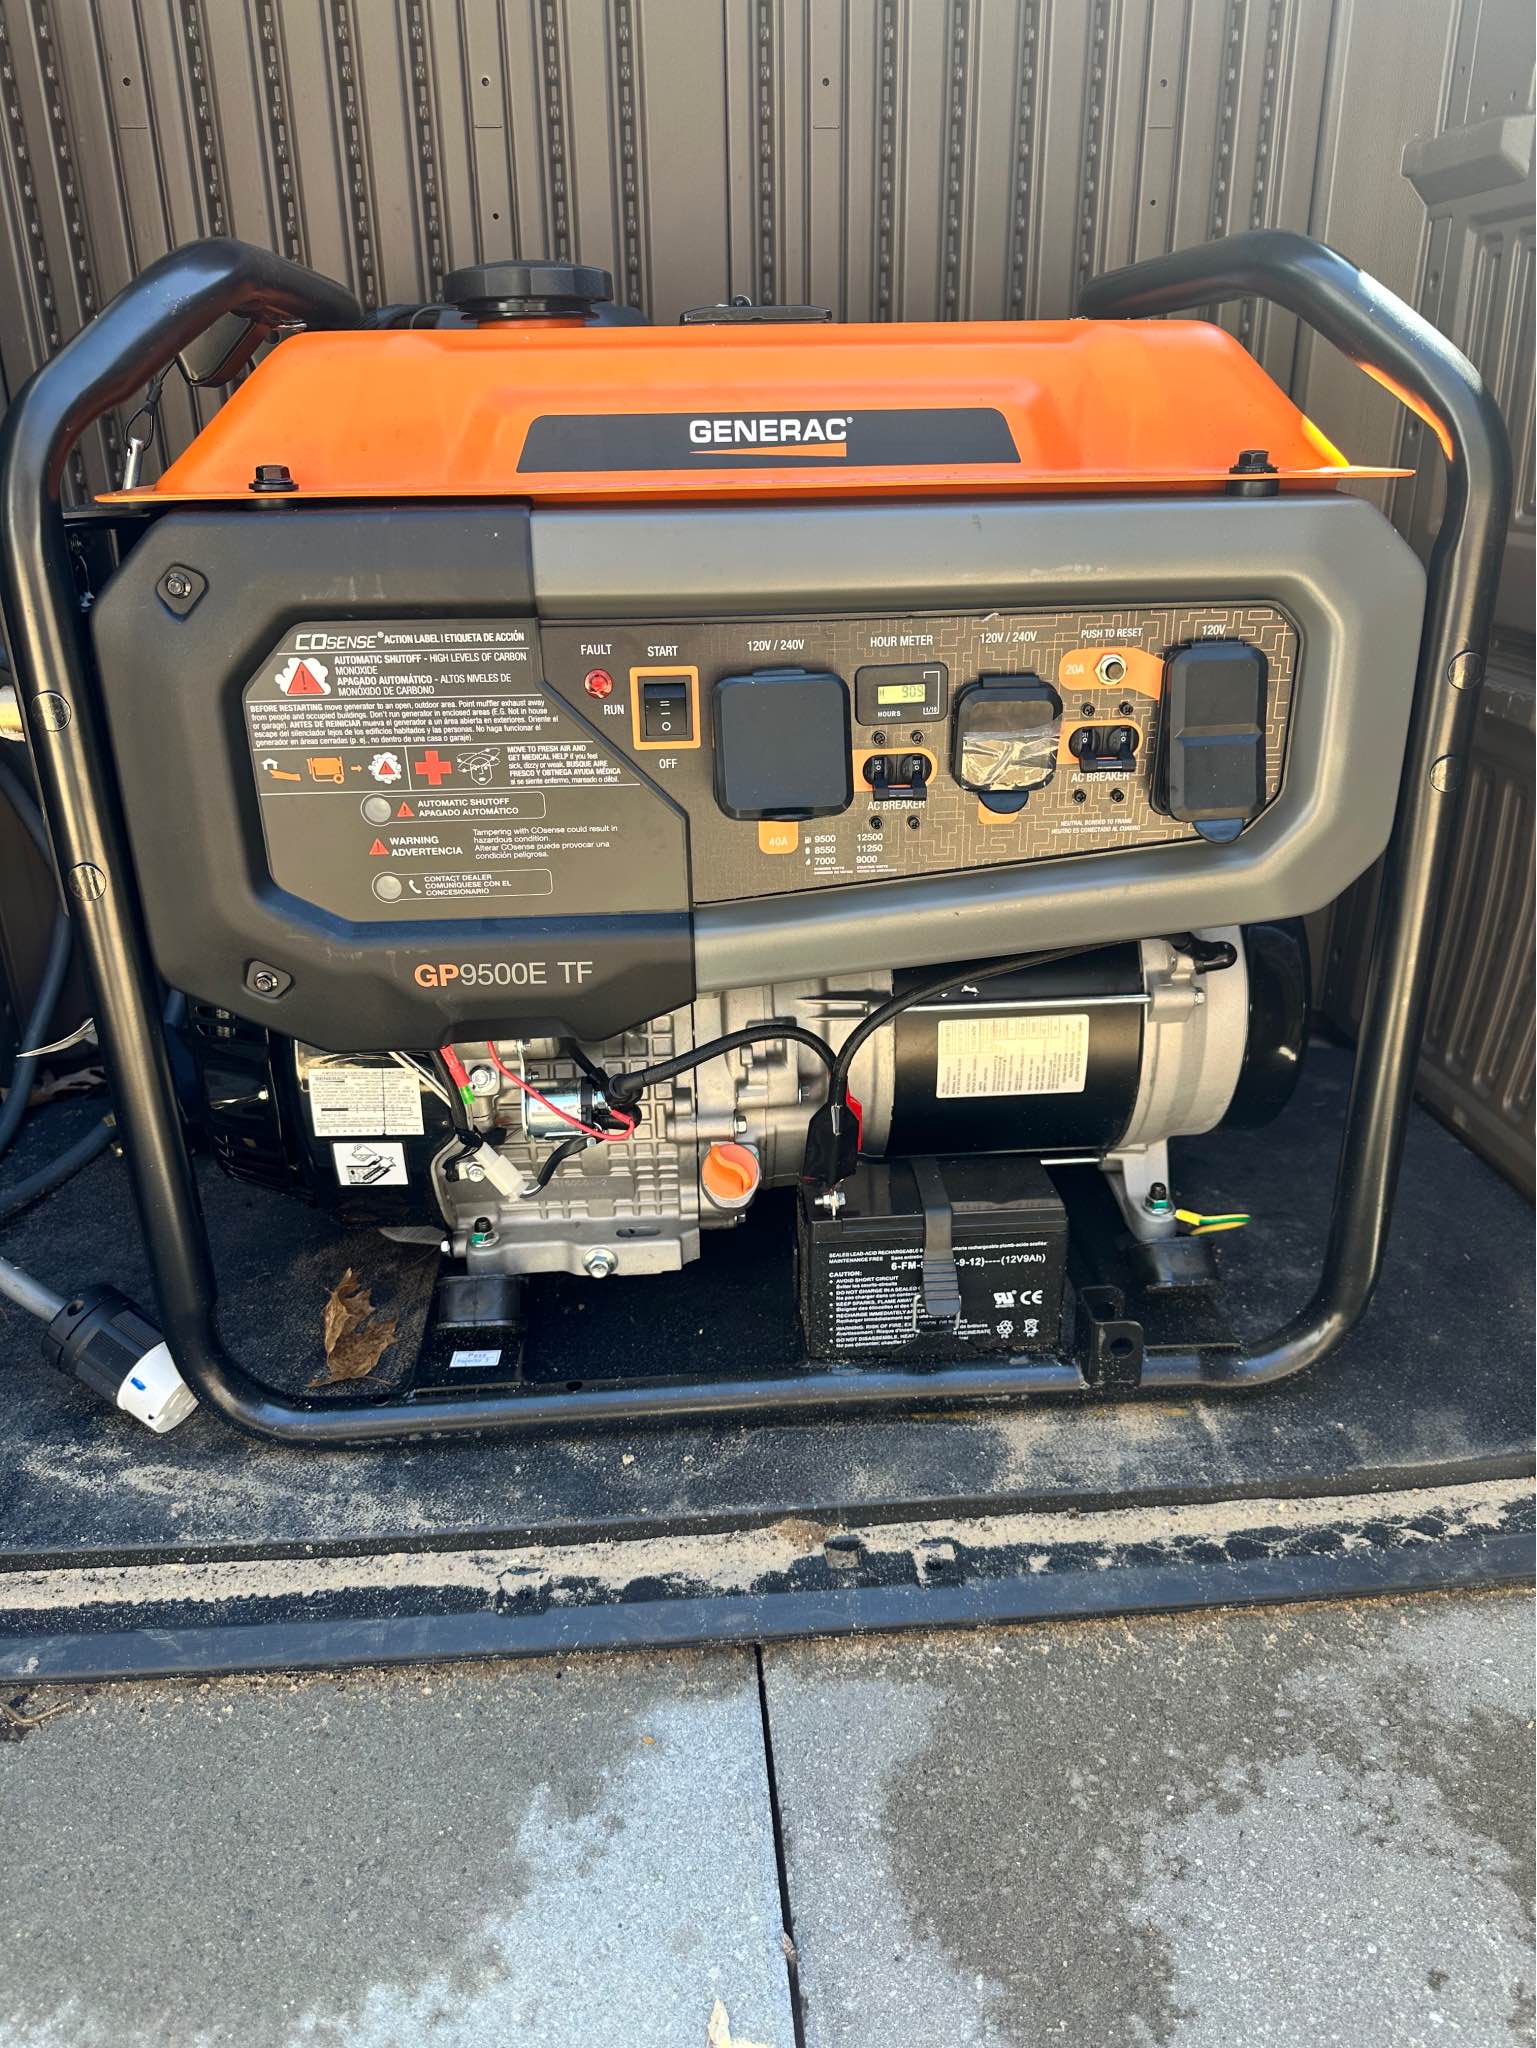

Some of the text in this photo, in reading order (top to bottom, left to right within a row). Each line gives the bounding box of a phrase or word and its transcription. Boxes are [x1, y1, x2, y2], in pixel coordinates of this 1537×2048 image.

[1081, 627, 1143, 639] PUSH TO RESET
[1202, 624, 1226, 636] 120V
[384, 634, 413, 644] ACTION
[415, 633, 440, 643] LABEL
[444, 632, 482, 643] ETIQUETA
[483, 632, 494, 642] DE
[495, 629, 525, 642] ACCIÓN
[870, 635, 934, 648] HOUR METER
[980, 632, 1004, 644] 120V
[1012, 631, 1037, 643] 240V
[580, 644, 612, 655] FAULT
[647, 645, 678, 657] START
[747, 640, 771, 652] 120V
[780, 639, 805, 650] 240V
[334, 655, 382, 665] AUTOMATIC
[384, 654, 421, 664] SHUTOFF
[429, 653, 449, 663] HIGH
[450, 652, 479, 662] LEVELS
[481, 652, 492, 662] OF
[493, 651, 527, 661] CARBON
[335, 665, 378, 676] MONOXIDE
[1065, 664, 1085, 675] 20A
[337, 676, 376, 686] APAGADO
[379, 673, 432, 685] AUTOMÁTICO
[440, 674, 465, 684] ALTOS
[466, 673, 499, 683] NIVELES
[500, 673, 511, 683] DE
[338, 684, 435, 697] MONÓXIDO DE CARBONO
[279, 704, 323, 712] RESTARTING
[344, 703, 375, 711] generator
[414, 701, 439, 709] outdoor
[501, 699, 526, 707] exhaust
[603, 704, 625, 715] RUN
[268, 713, 290, 721] people
[306, 712, 335, 720] occupied
[442, 708, 470, 716] enclosed
[659, 758, 678, 769] OFF
[1071, 772, 1130, 783] AC BREAKER
[417, 798, 510, 808] AUTOMATIC SHUTOFF
[867, 800, 926, 811] AC BREAKER
[419, 806, 519, 817] APAGADO AUTOMÁTICO
[472, 828, 512, 837] Tampering
[513, 827, 529, 835] with
[530, 826, 565, 834] COsense
[566, 825, 587, 833] could
[611, 824, 618, 832] in
[389, 836, 439, 845] WARNING
[474, 835, 550, 844] hazardous condition.
[769, 836, 788, 847] 40A
[814, 833, 883, 843] 9500 12500
[391, 846, 463, 857] ADVERTENCIA
[475, 844, 499, 852] Alterar
[501, 843, 535, 851] COsense
[537, 843, 560, 851] puede
[562, 842, 594, 850] provocar
[814, 844, 883, 854] 8550 11250
[475, 851, 512, 859] condición
[814, 855, 877, 865] 7000 9000
[424, 875, 460, 883] CONTACT
[425, 887, 490, 896] CONCESIONARIO
[414, 961, 593, 987] GP9500E TF
[828, 1256, 868, 1264] MAINTENANCE
